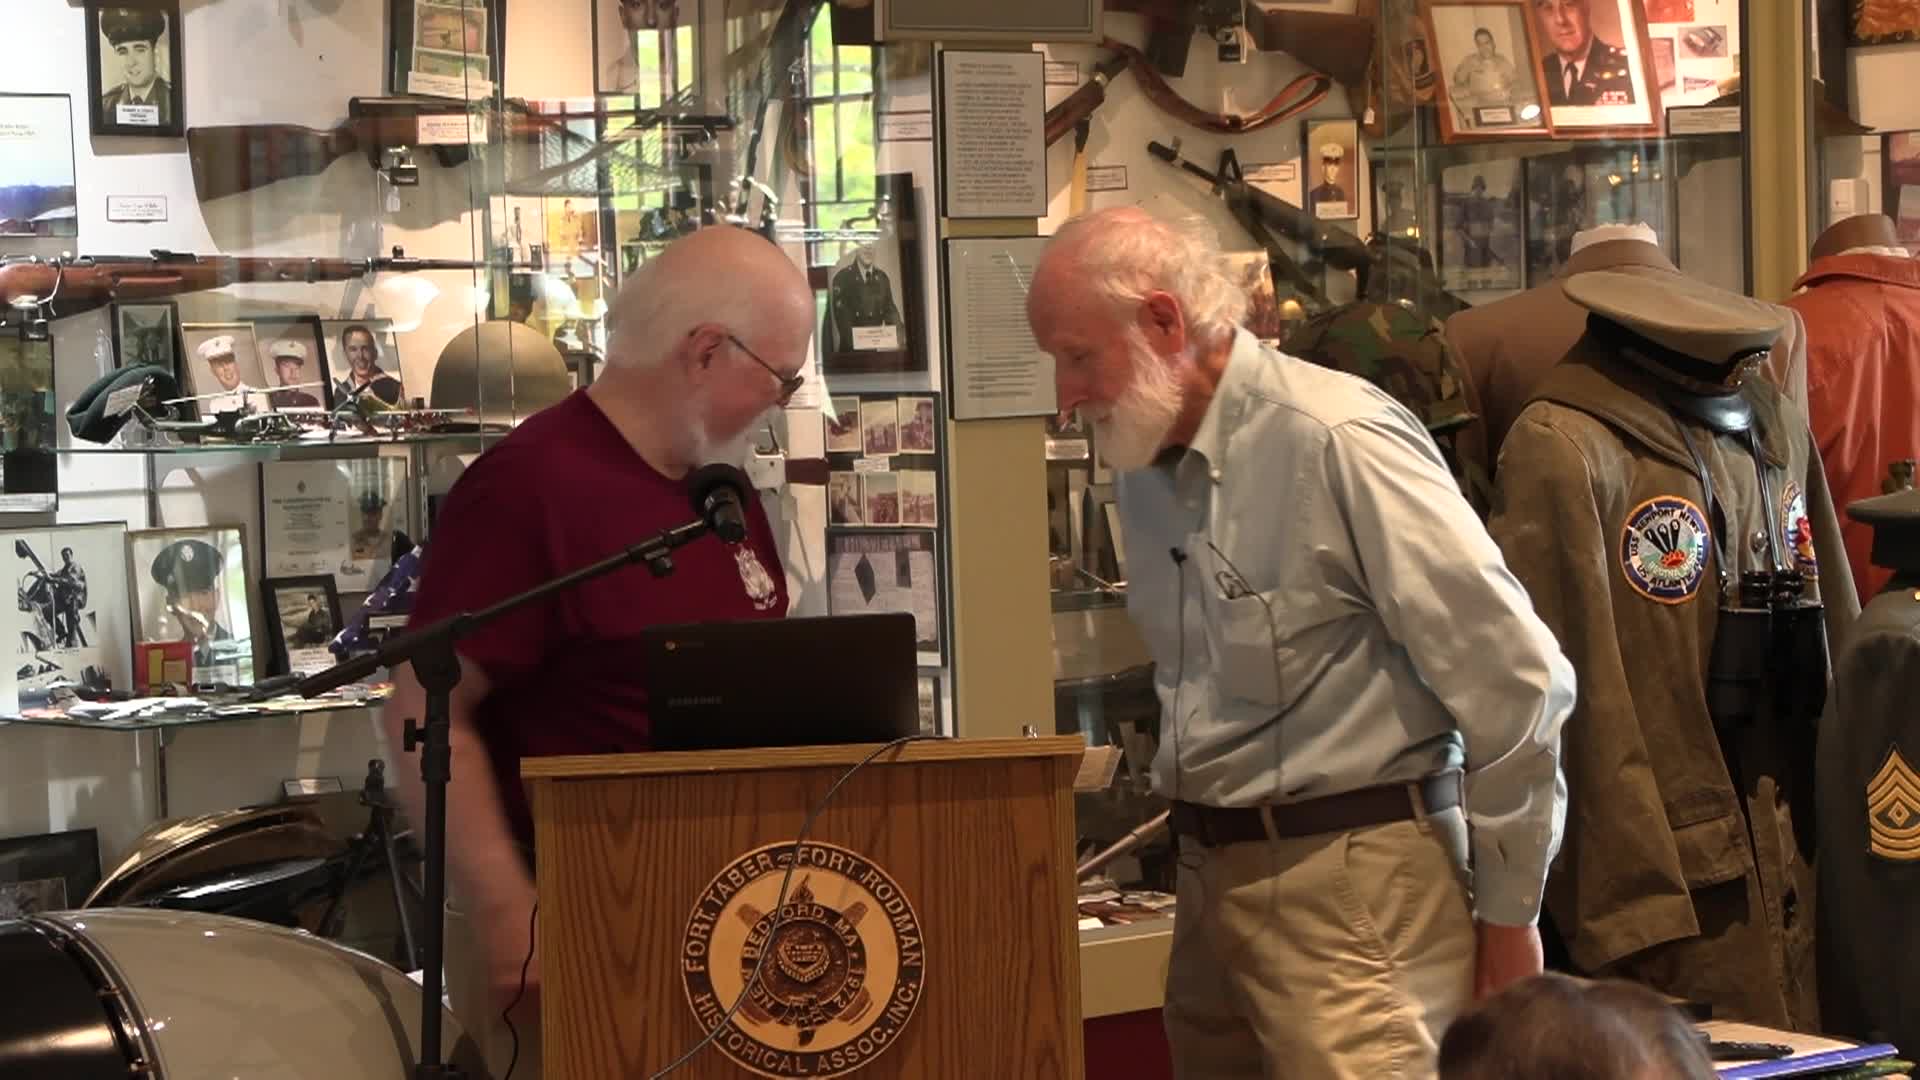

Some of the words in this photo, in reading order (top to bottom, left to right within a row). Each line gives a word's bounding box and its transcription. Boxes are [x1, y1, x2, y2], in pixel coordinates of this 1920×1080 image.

[1637, 508, 1675, 531] NEWPORT
[1679, 510, 1700, 533] NEWS
[705, 852, 775, 908] TABER
[834, 918, 858, 948] MA
[860, 868, 922, 967] RODMAN
[695, 993, 809, 1073] HISTORICAL
